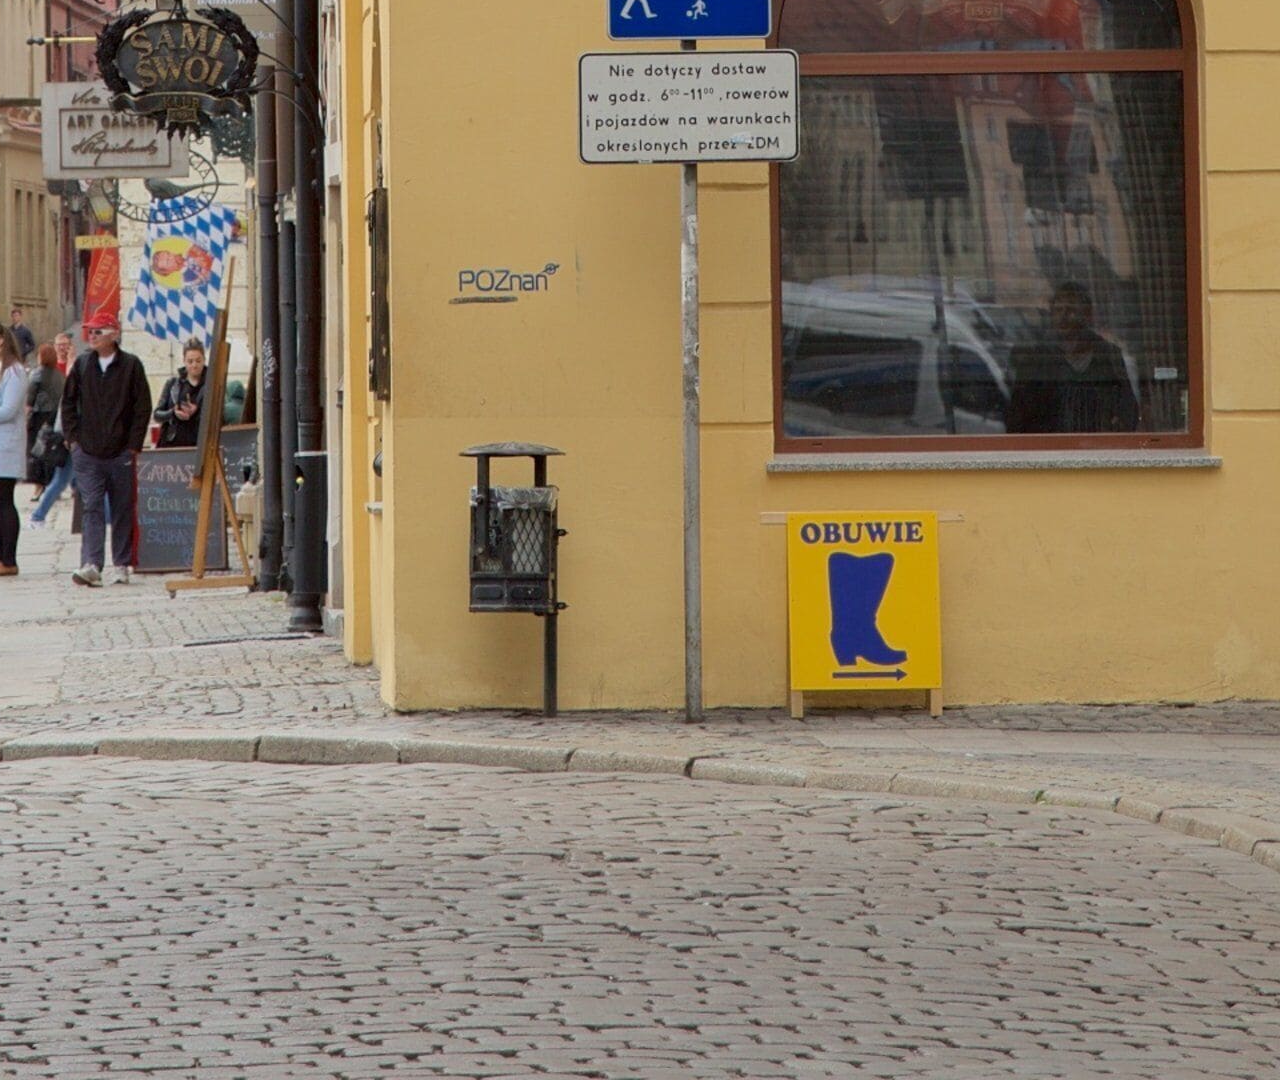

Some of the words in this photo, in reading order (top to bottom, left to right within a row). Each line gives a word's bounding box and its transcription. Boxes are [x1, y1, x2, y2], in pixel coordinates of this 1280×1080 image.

[130, 22, 226, 58] SAMI
[136, 55, 224, 89] SWOI
[609, 64, 634, 77] Nie
[644, 63, 701, 79] dotyczy
[711, 62, 766, 75] dostaw
[588, 93, 598, 102] w
[608, 89, 651, 105] godz.
[67, 114, 95, 129] ART
[586, 114, 590, 127] i
[595, 114, 669, 131] pojazdów
[678, 115, 697, 125] na
[707, 112, 791, 125] warunkach
[698, 139, 737, 153] przez
[800, 521, 924, 544] OBUWIE
